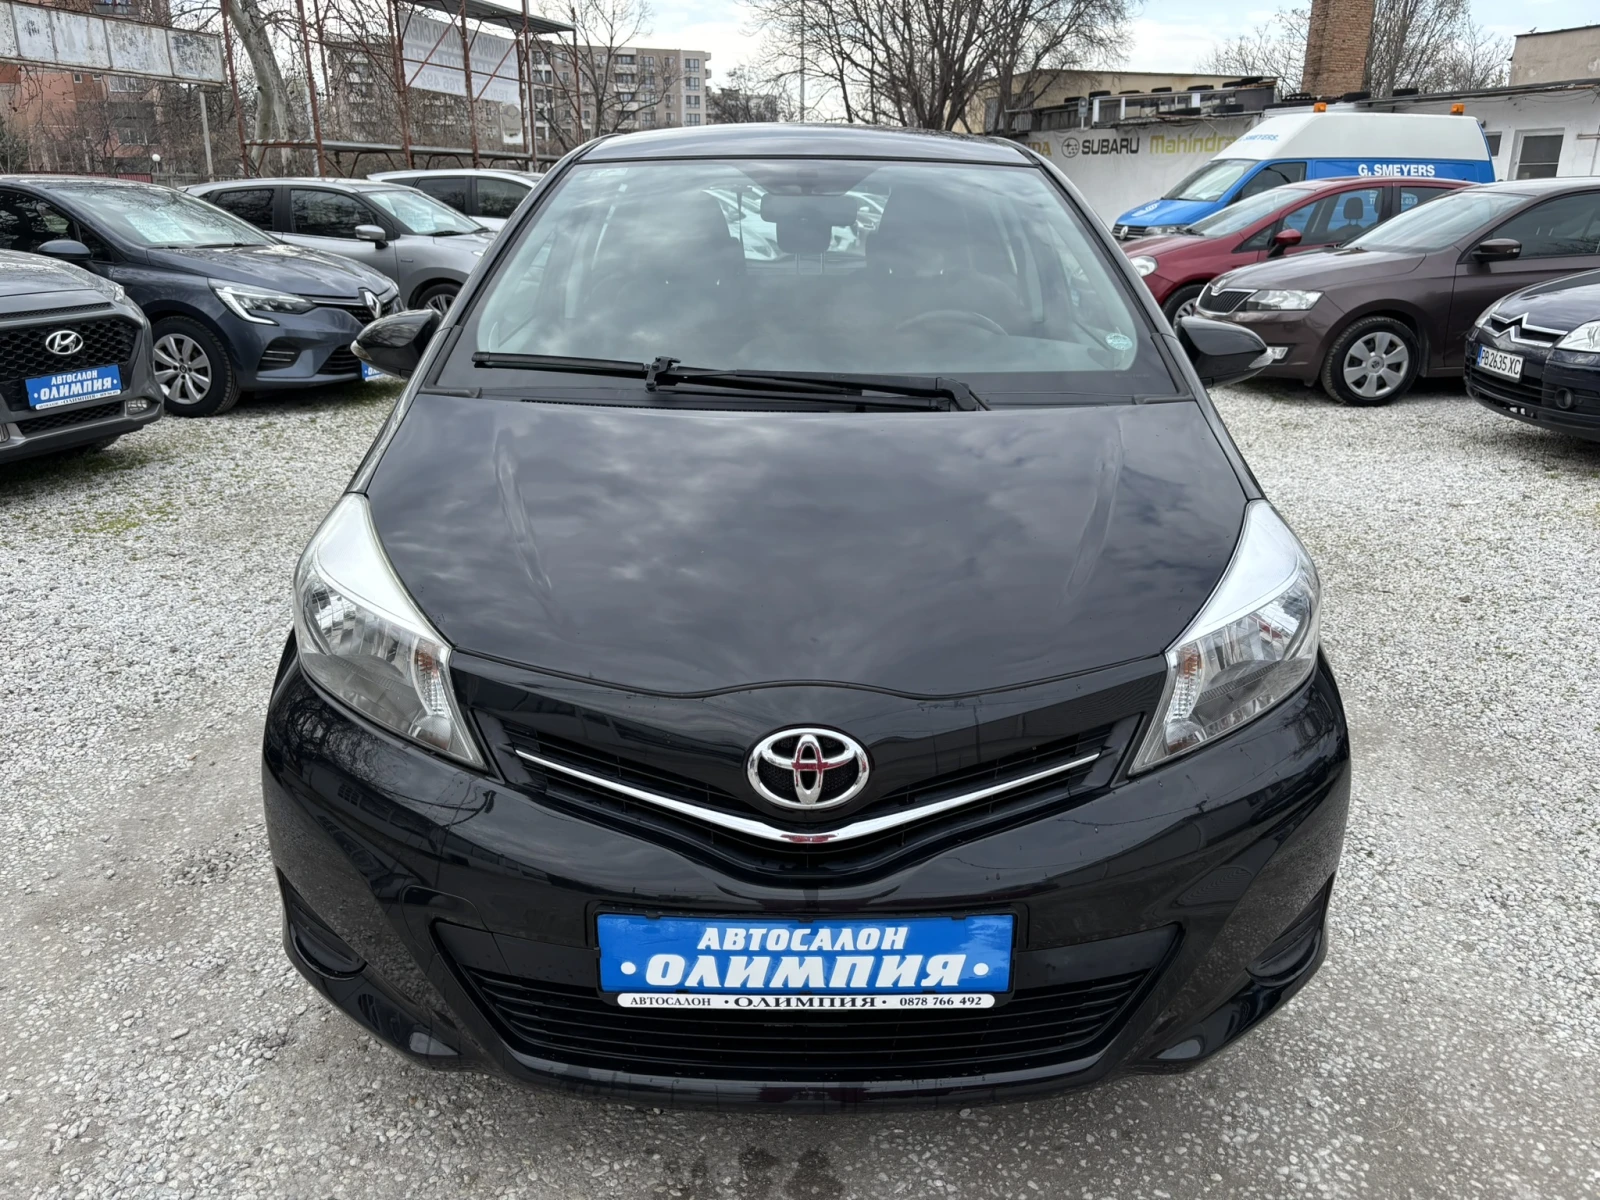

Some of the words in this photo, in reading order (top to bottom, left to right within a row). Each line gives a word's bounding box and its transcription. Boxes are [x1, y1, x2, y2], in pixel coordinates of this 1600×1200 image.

[1081, 137, 1140, 155] SUBARU
[1358, 164, 1371, 176] G.
[1374, 164, 1436, 176] SMEYERS
[51, 370, 98, 385] АВТОСАЛОН
[40, 377, 112, 400] ОЛИМПИЯ
[697, 927, 908, 951] АВТОСАЛОН
[645, 954, 967, 988] ОЛИМПИЯ
[630, 996, 711, 1006] АВТОСАЛОН
[733, 997, 877, 1008] ОЛИМПИЯ
[899, 997, 928, 1007] 0878
[932, 997, 954, 1006] 766
[959, 996, 982, 1006] 492
